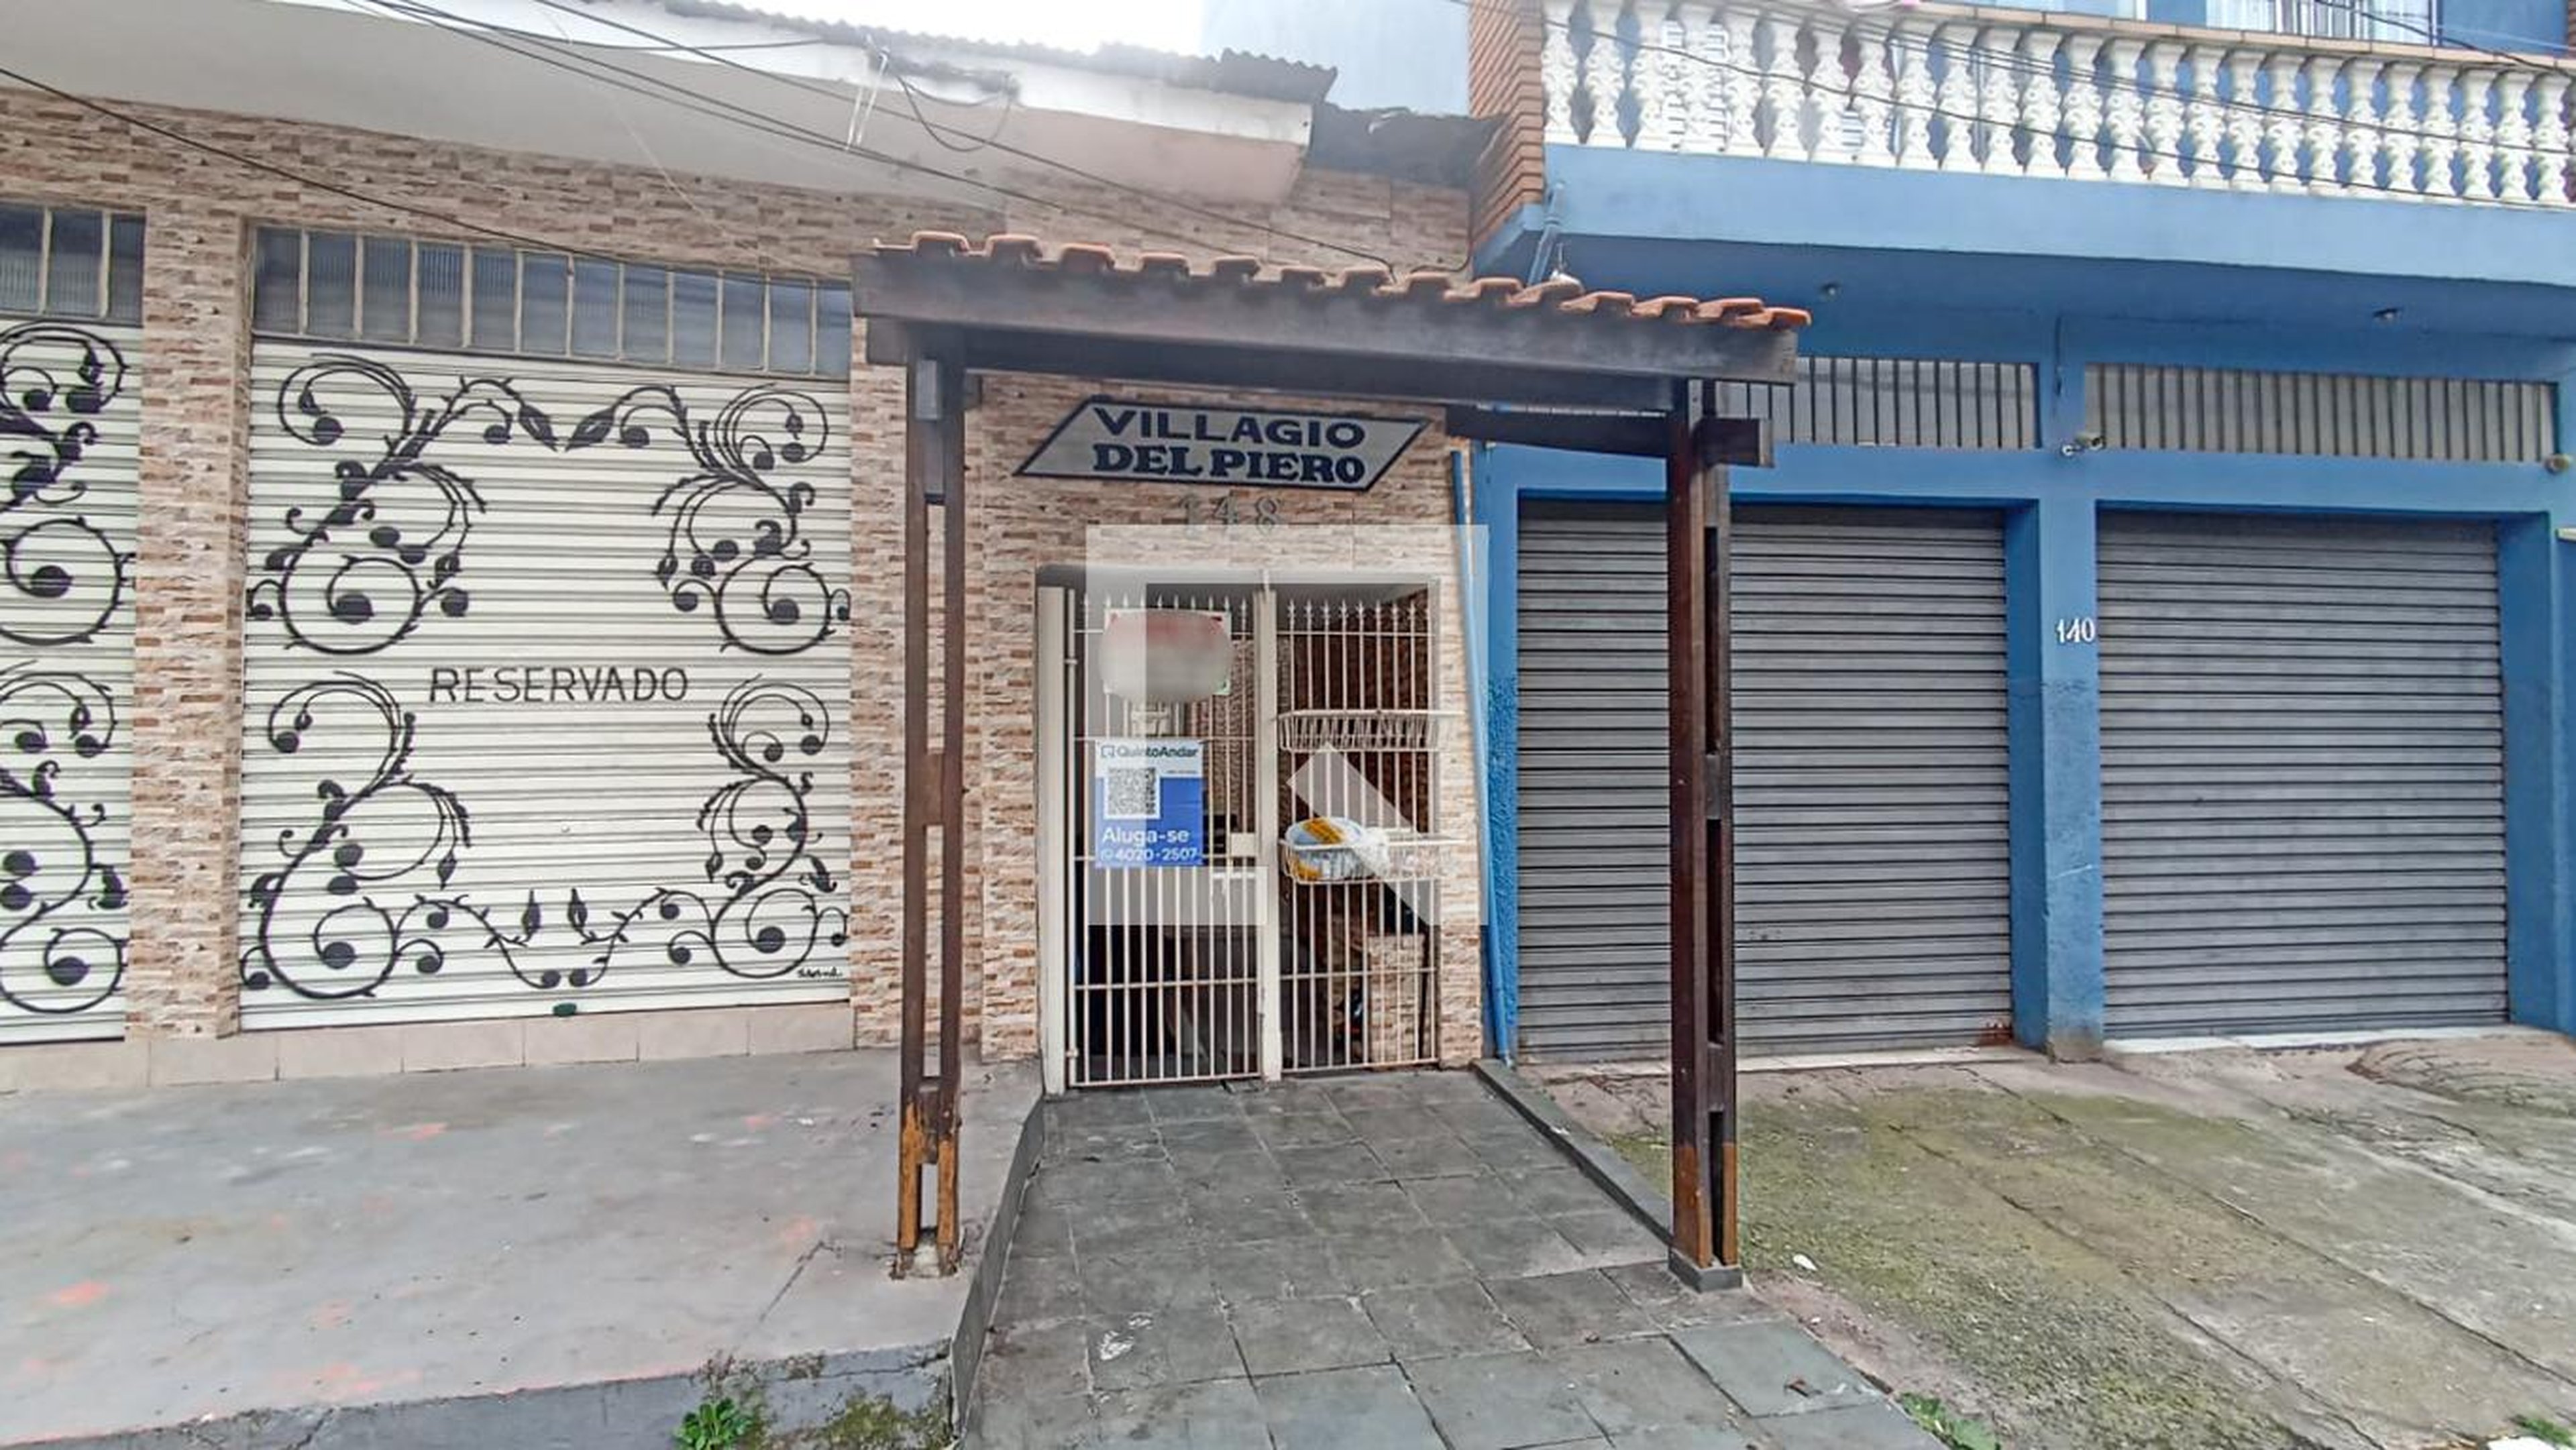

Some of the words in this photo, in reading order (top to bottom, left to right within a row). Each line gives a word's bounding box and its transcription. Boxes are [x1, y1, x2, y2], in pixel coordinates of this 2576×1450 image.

[1093, 406, 1366, 449] VILLAGIO
[1093, 443, 1203, 477] DEL
[1210, 448, 1366, 484] PIERO
[1179, 492, 1280, 535] 148
[429, 667, 689, 703] RESERVADO
[1116, 745, 1198, 759] QuintoAndar
[1102, 827, 1190, 847] Aluga-se
